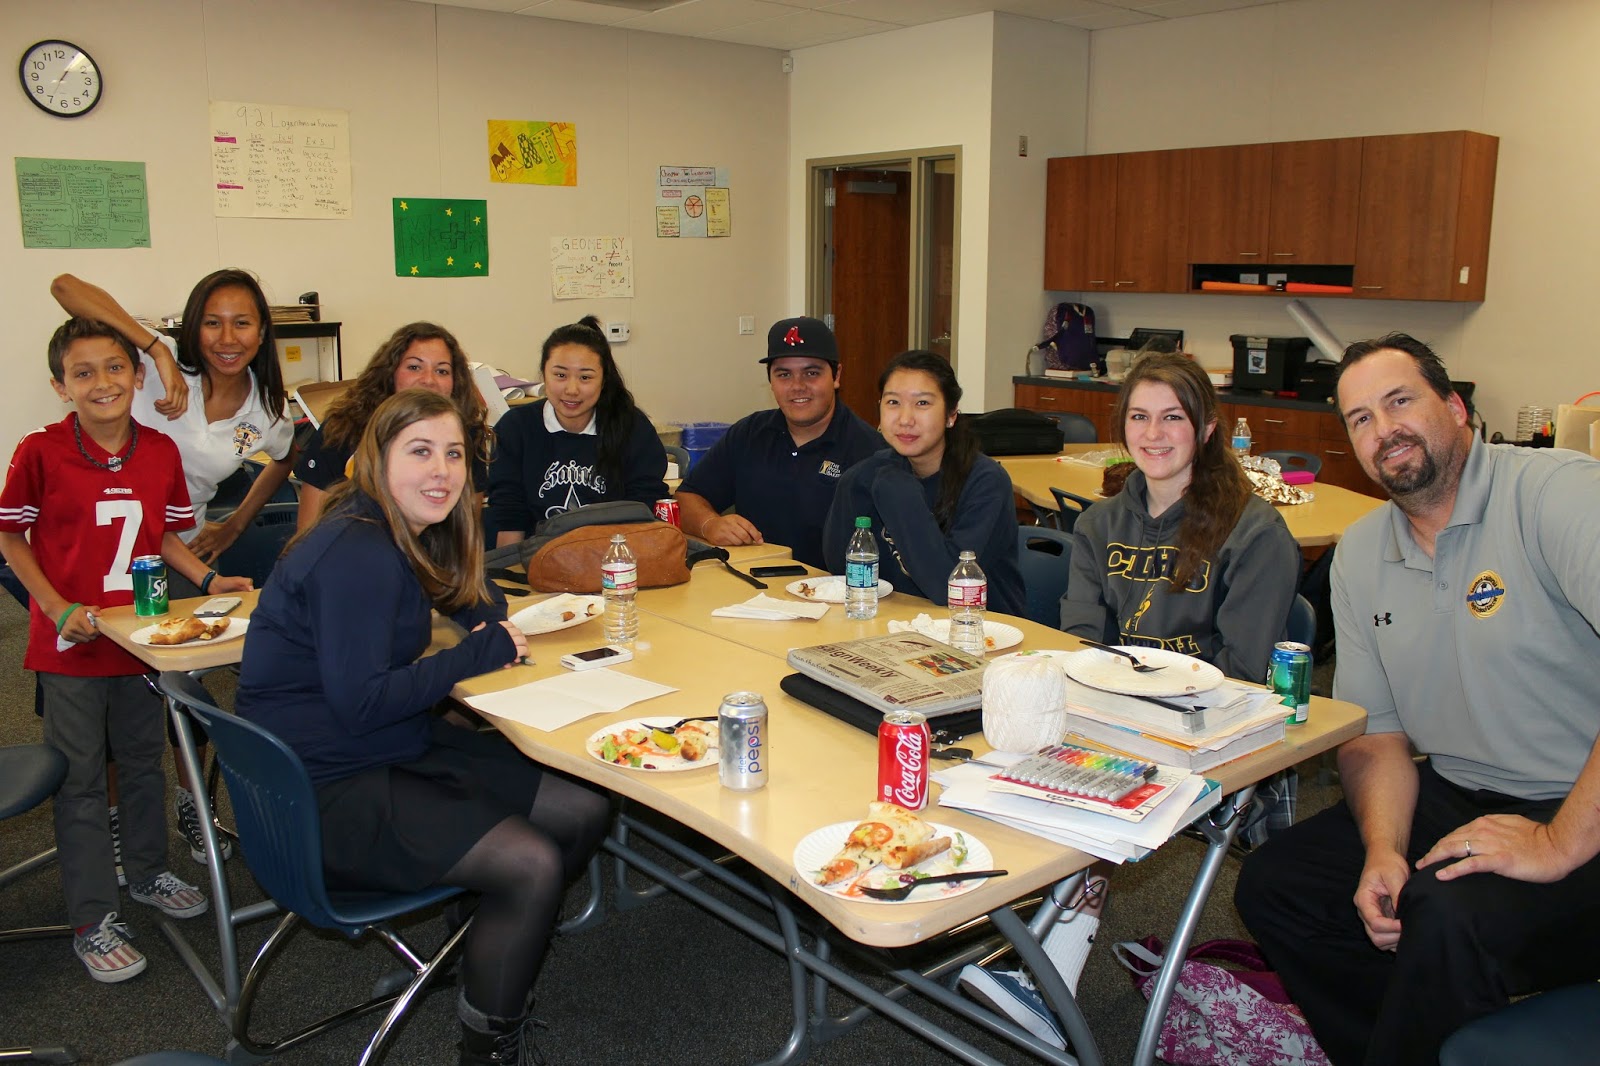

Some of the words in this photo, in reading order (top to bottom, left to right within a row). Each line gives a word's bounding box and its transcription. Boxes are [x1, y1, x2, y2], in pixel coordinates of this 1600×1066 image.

[43, 53, 51, 61] 11
[54, 50, 65, 59] 12
[33, 61, 45, 70] 10
[80, 66, 87, 74] 2
[31, 72, 39, 81] 9
[84, 77, 92, 85] 3
[36, 85, 44, 94] 8
[82, 89, 89, 97] 4
[47, 95, 53, 103] 7
[73, 97, 81, 106] 5
[60, 100, 68, 108] 6
[491, 122, 576, 181] MATH
[562, 237, 625, 251] GEOMETRY
[539, 459, 606, 498] Saints
[95, 500, 143, 593] 7
[746, 719, 763, 774] pepsi
[895, 727, 922, 808] Coca-Cola
